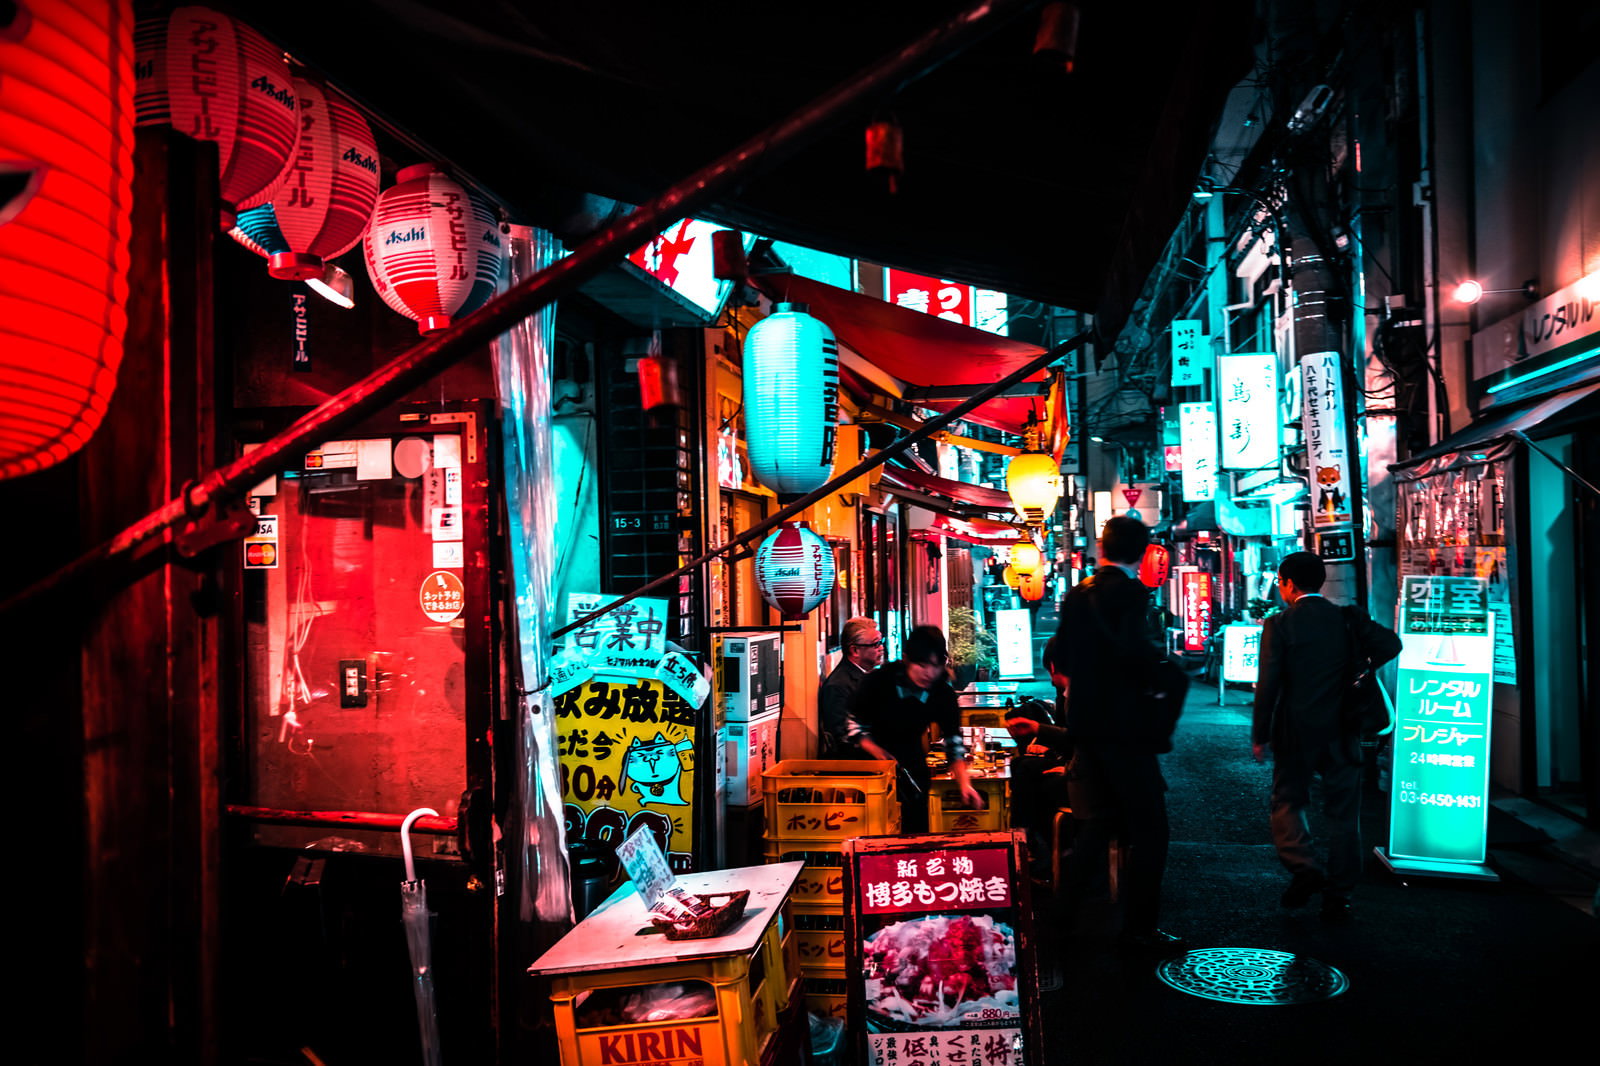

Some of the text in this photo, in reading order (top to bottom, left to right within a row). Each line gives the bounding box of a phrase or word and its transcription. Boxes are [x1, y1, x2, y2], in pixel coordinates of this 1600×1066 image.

[251, 75, 295, 111] Asahi
[343, 147, 377, 174] Asahi
[385, 227, 425, 245] Asahi
[441, 192, 469, 281] アサヒビール
[292, 293, 309, 362] アサヒビール
[615, 518, 641, 528] 15-3
[774, 567, 801, 577] Asahi
[811, 544, 823, 597] アサヒビール
[1410, 581, 1483, 615] 空室
[573, 603, 663, 652] 営業中
[1410, 678, 1480, 698] レンタル
[1418, 699, 1472, 717] ルーム
[1403, 725, 1483, 746] プレジャー
[1400, 791, 1481, 807] 03-6450-1431
[787, 811, 858, 831] ホッピー
[896, 856, 975, 878] 新名物
[866, 875, 1008, 908] 博多もつ焼き
[599, 1028, 703, 1064] KIRIN
[946, 1035, 967, 1066] くせ
